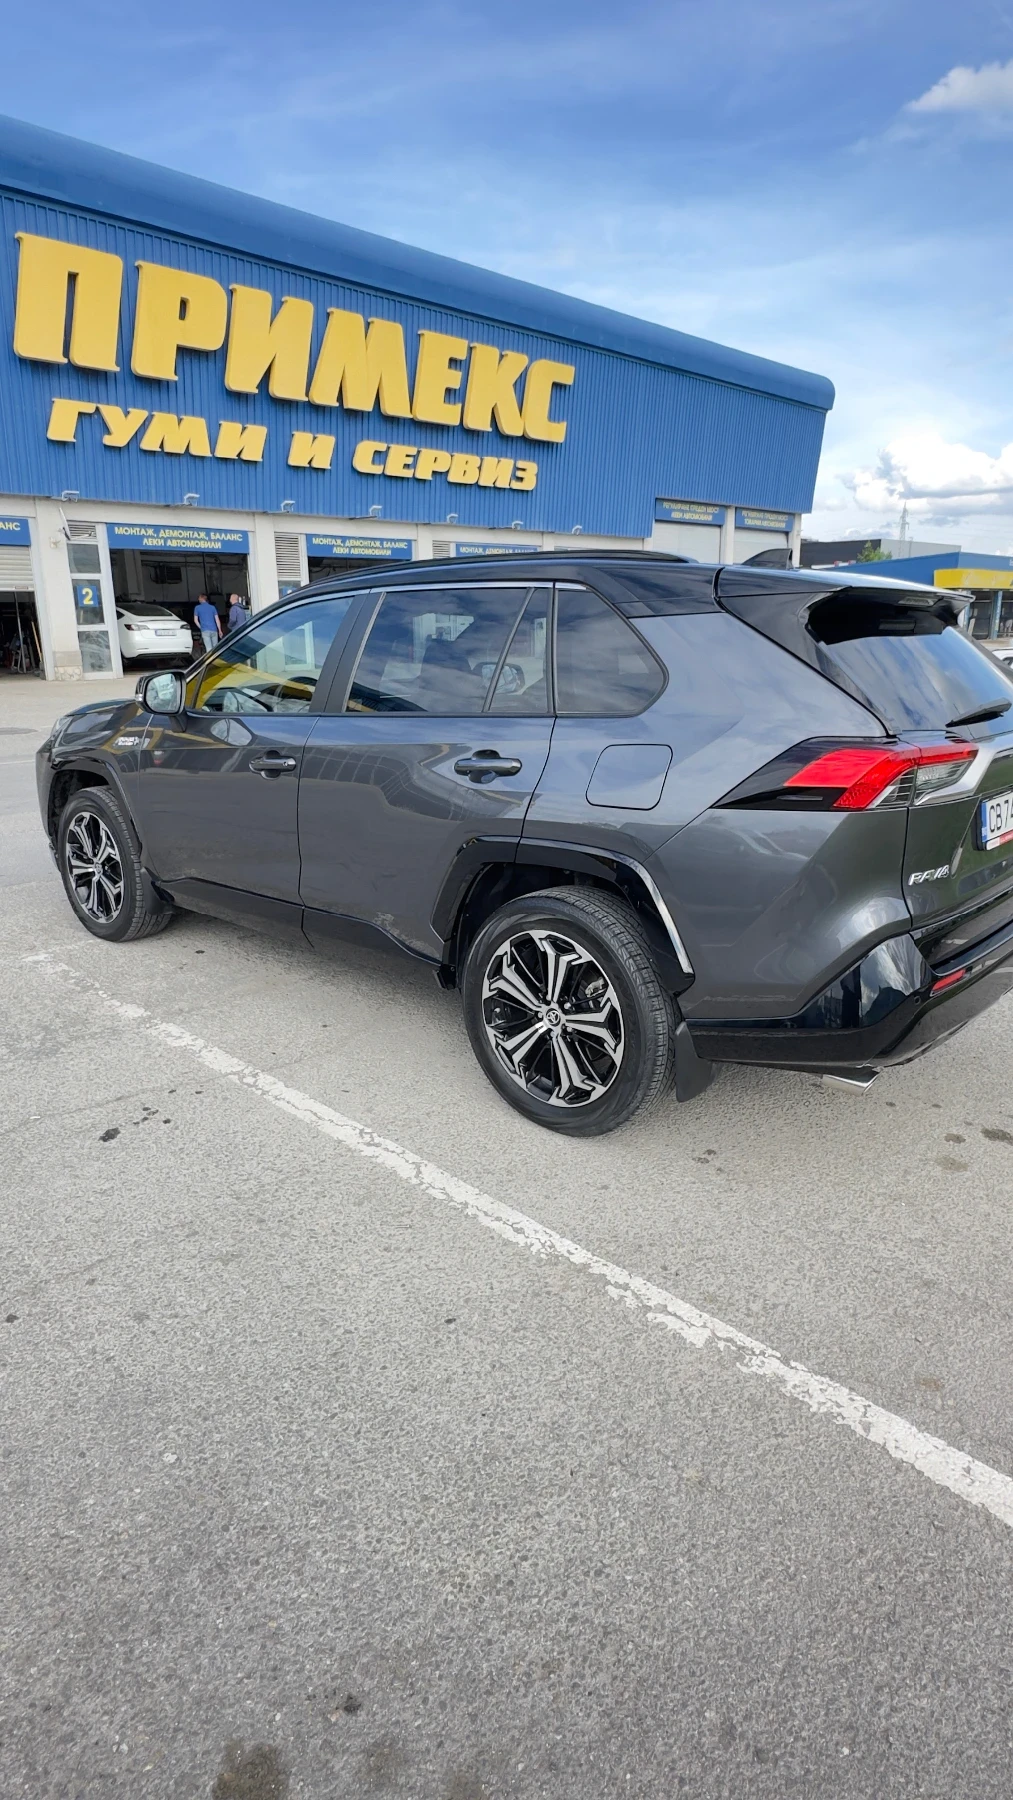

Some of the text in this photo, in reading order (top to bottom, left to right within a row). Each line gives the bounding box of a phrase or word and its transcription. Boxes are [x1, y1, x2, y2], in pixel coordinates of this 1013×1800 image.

[14, 231, 575, 443] ПРИМЕКС
[47, 398, 538, 491] ГУМИ И СЕРВИЗ
[114, 526, 243, 542] МОНТАЖ, ДЕМОНТАЖ, БАЛАНС
[143, 537, 222, 549] ЛЕКИ АВТОМОБИЛИ
[82, 587, 94, 605] 2
